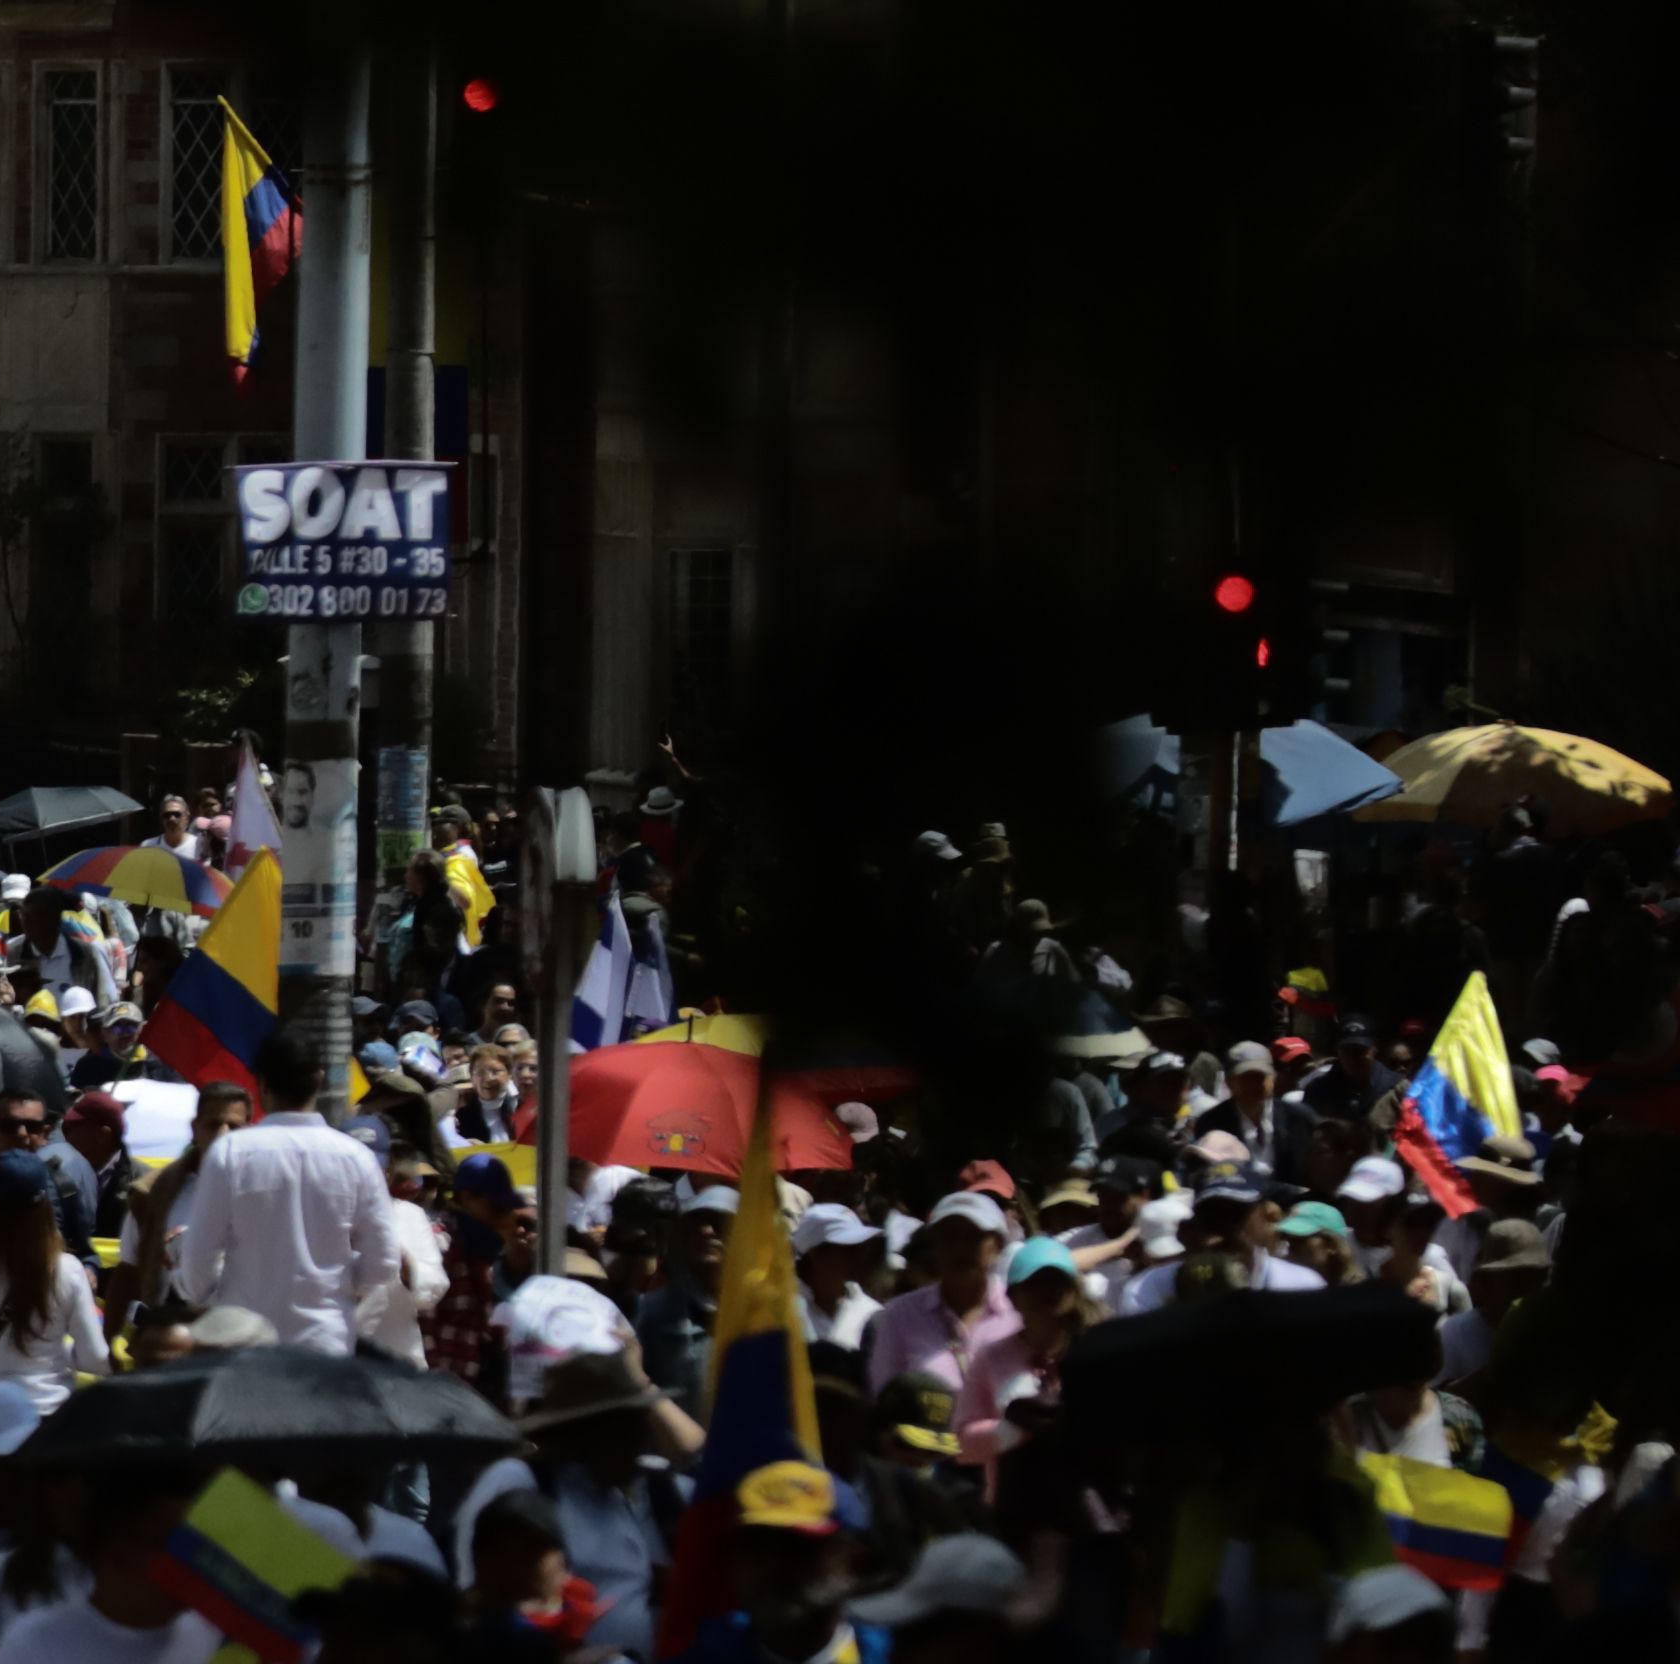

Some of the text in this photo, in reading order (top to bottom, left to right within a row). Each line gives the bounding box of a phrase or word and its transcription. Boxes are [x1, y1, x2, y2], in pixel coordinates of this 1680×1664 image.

[243, 467, 447, 542] SOAT
[315, 545, 331, 575] 5
[338, 546, 388, 575] #30
[410, 547, 445, 577] 35
[268, 585, 314, 614] 302
[380, 586, 408, 615] 01
[414, 587, 447, 614] 73
[291, 921, 313, 938] 10
